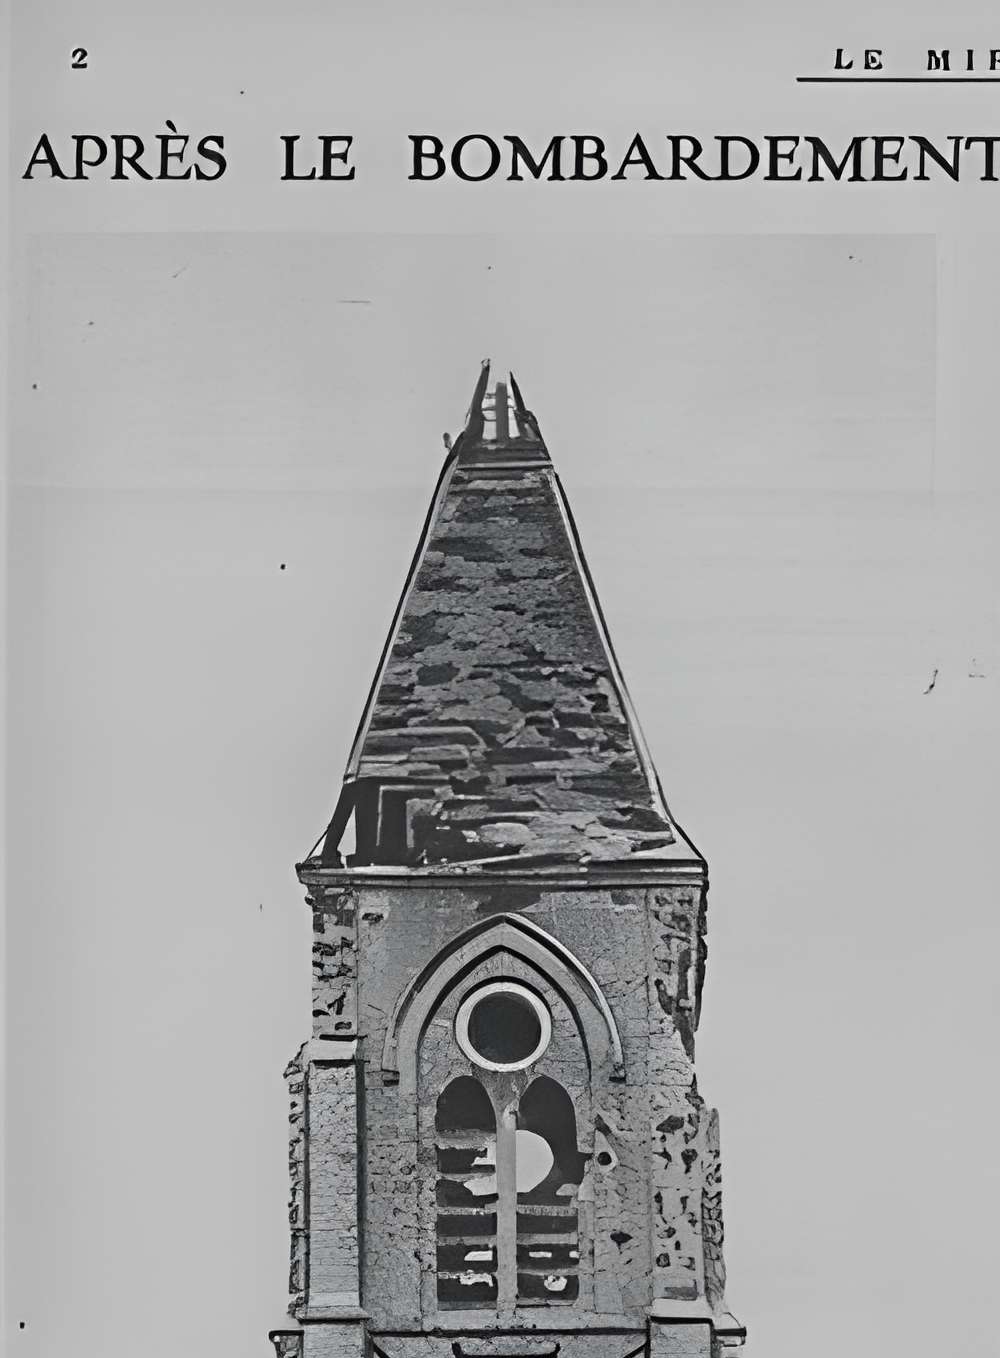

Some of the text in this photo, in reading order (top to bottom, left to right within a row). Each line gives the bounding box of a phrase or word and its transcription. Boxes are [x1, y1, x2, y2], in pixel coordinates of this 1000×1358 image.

[71, 47, 89, 70] 2
[833, 47, 884, 71] LE
[20, 119, 228, 182] APRÈS
[279, 134, 356, 181] LE
